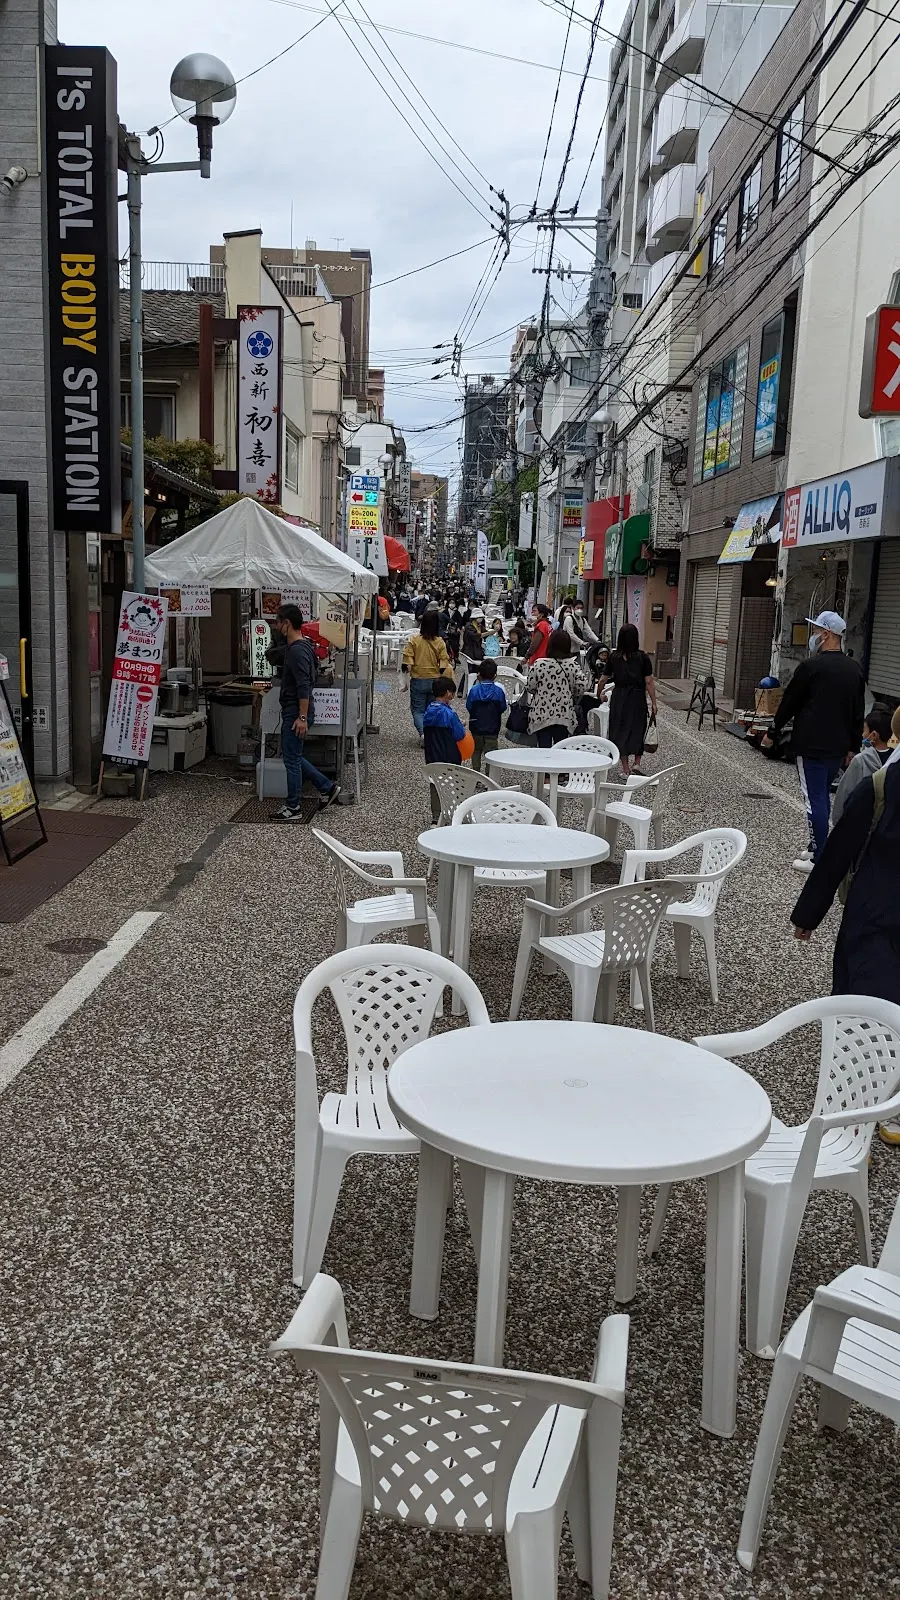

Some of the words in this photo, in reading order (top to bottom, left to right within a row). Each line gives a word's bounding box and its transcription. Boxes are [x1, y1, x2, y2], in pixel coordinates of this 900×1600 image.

[56, 66, 93, 111] I'S
[57, 125, 94, 240] TOTAL
[60, 253, 97, 354] BODY
[62, 367, 100, 512] STATION
[352, 476, 377, 490] Parking
[802, 480, 852, 536] ALLIQ
[784, 493, 800, 541] 酒
[117, 641, 161, 660] 夢まつり
